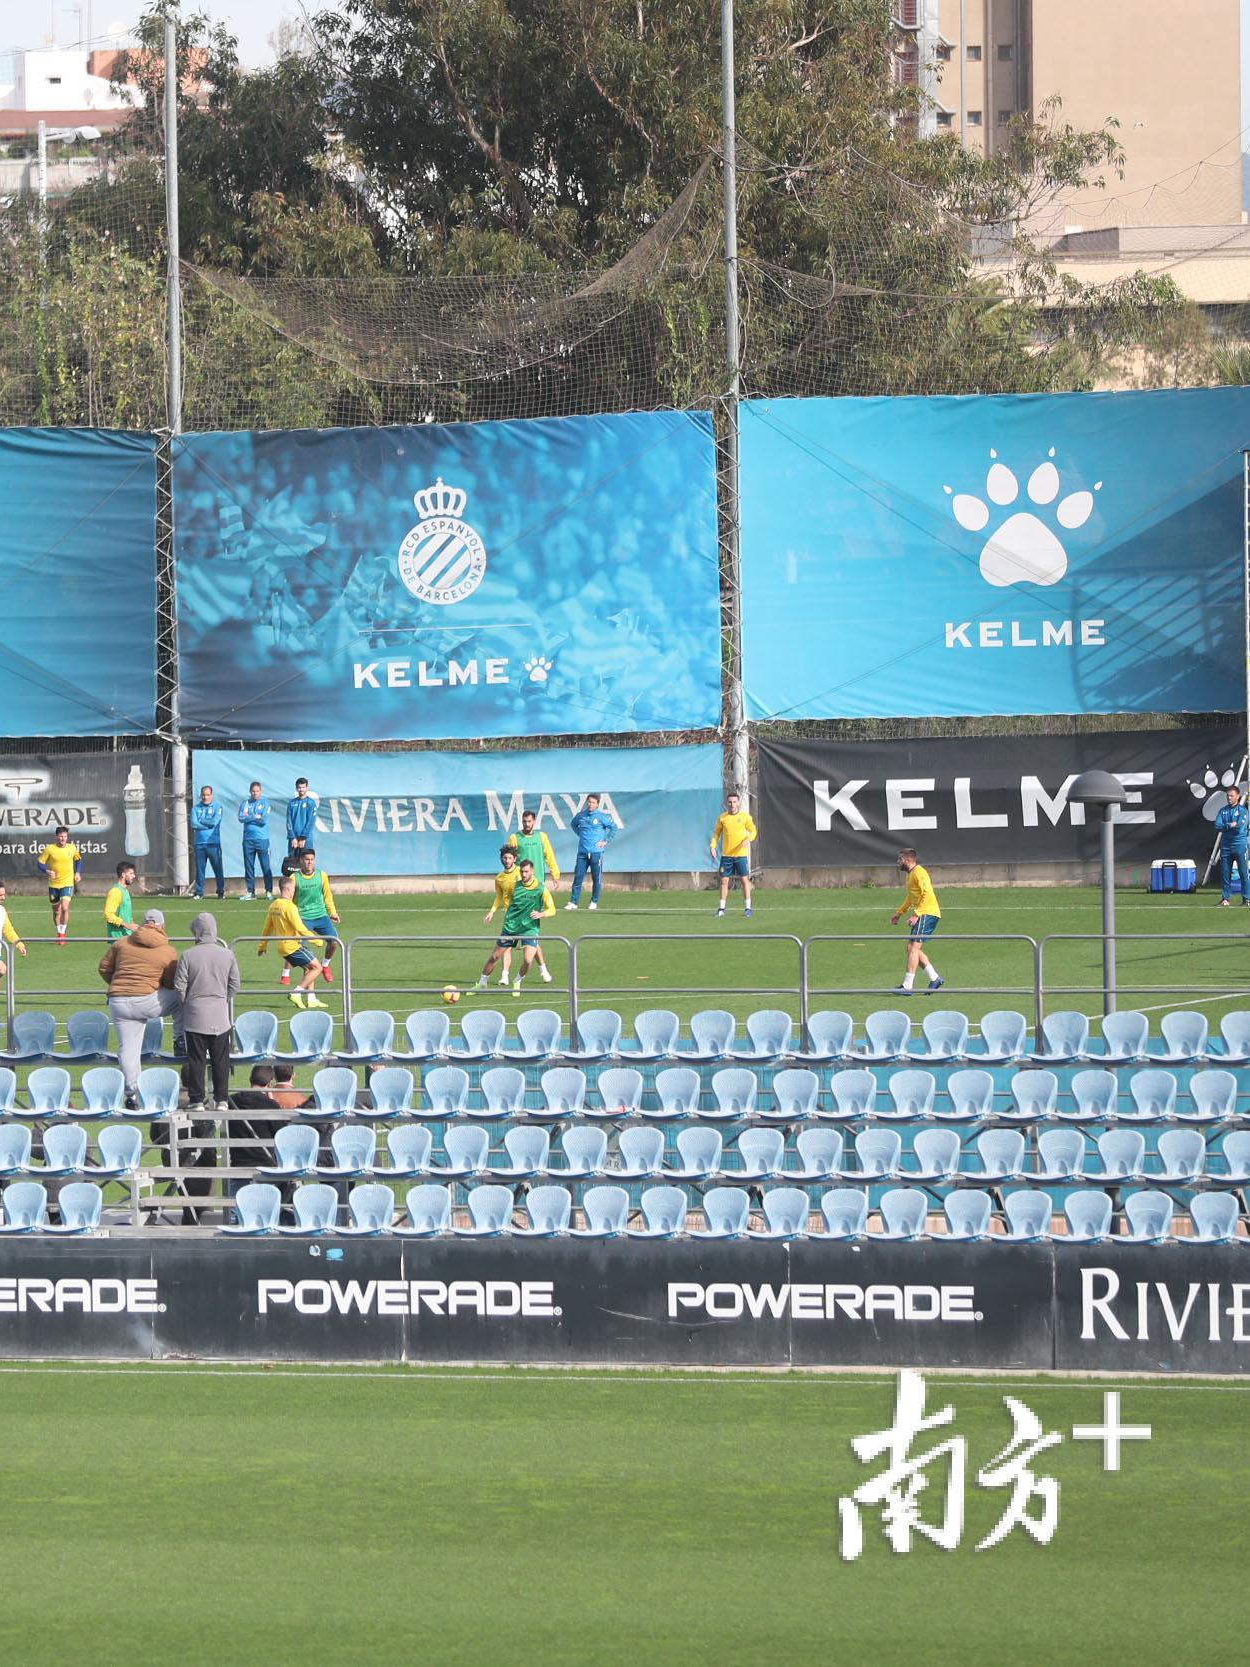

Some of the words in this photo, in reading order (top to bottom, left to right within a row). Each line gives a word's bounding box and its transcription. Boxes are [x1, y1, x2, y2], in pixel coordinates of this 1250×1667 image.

[402, 532, 420, 558] RCD
[422, 520, 481, 555] ESPANYOL
[416, 564, 483, 601] BARCELONA
[945, 619, 1105, 648] KELME
[353, 658, 510, 689] KELME
[483, 790, 624, 832] MAYA
[813, 772, 1156, 831] KELME
[29, 839, 108, 855] deistas
[257, 1278, 555, 1316] POWERADE
[667, 1282, 975, 1321] POWERADE
